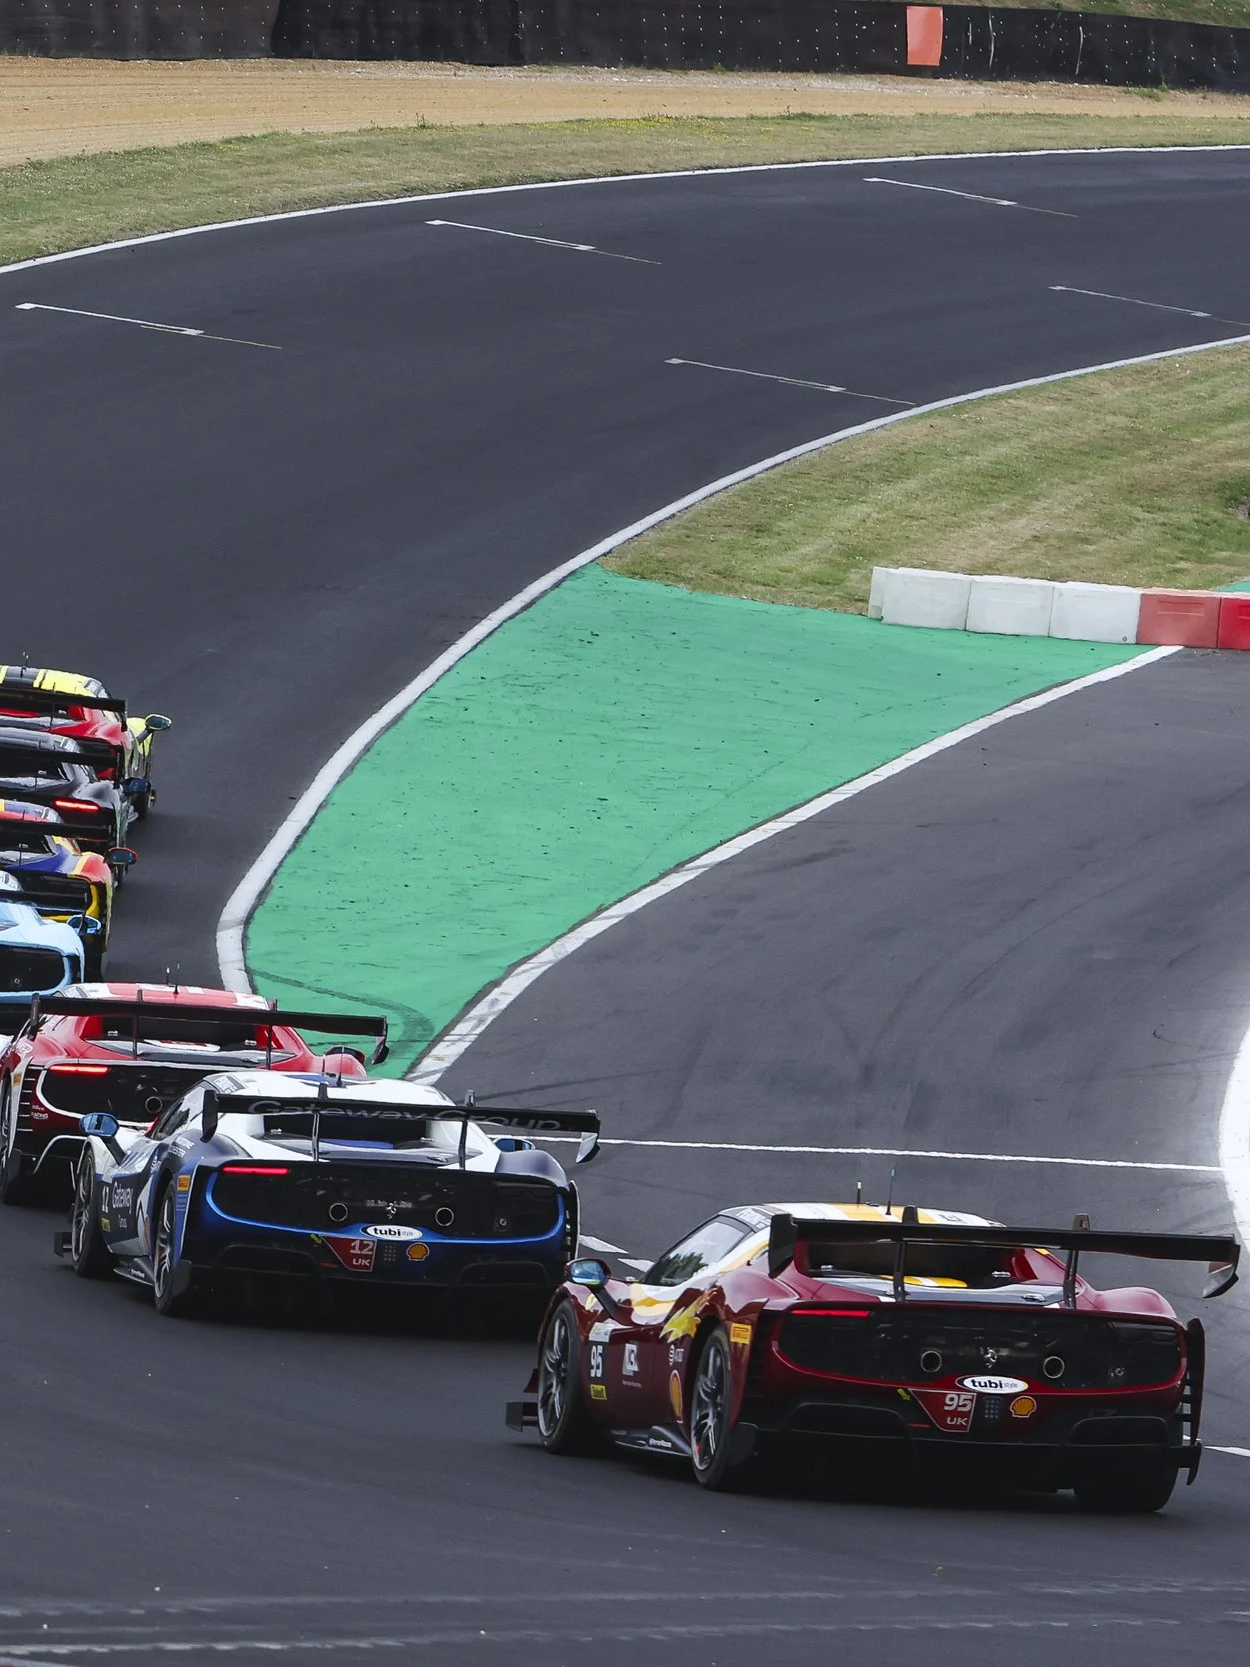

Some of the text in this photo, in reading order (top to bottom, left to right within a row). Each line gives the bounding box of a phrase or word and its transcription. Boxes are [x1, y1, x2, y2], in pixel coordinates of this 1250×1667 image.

[102, 1185, 110, 1213] 12
[373, 1227, 401, 1237] tubi
[350, 1240, 374, 1255] 12
[352, 1258, 370, 1266] UK
[590, 1345, 603, 1378] 95
[971, 1379, 1003, 1389] tubi
[944, 1393, 972, 1412] 95
[946, 1417, 968, 1426] UK
